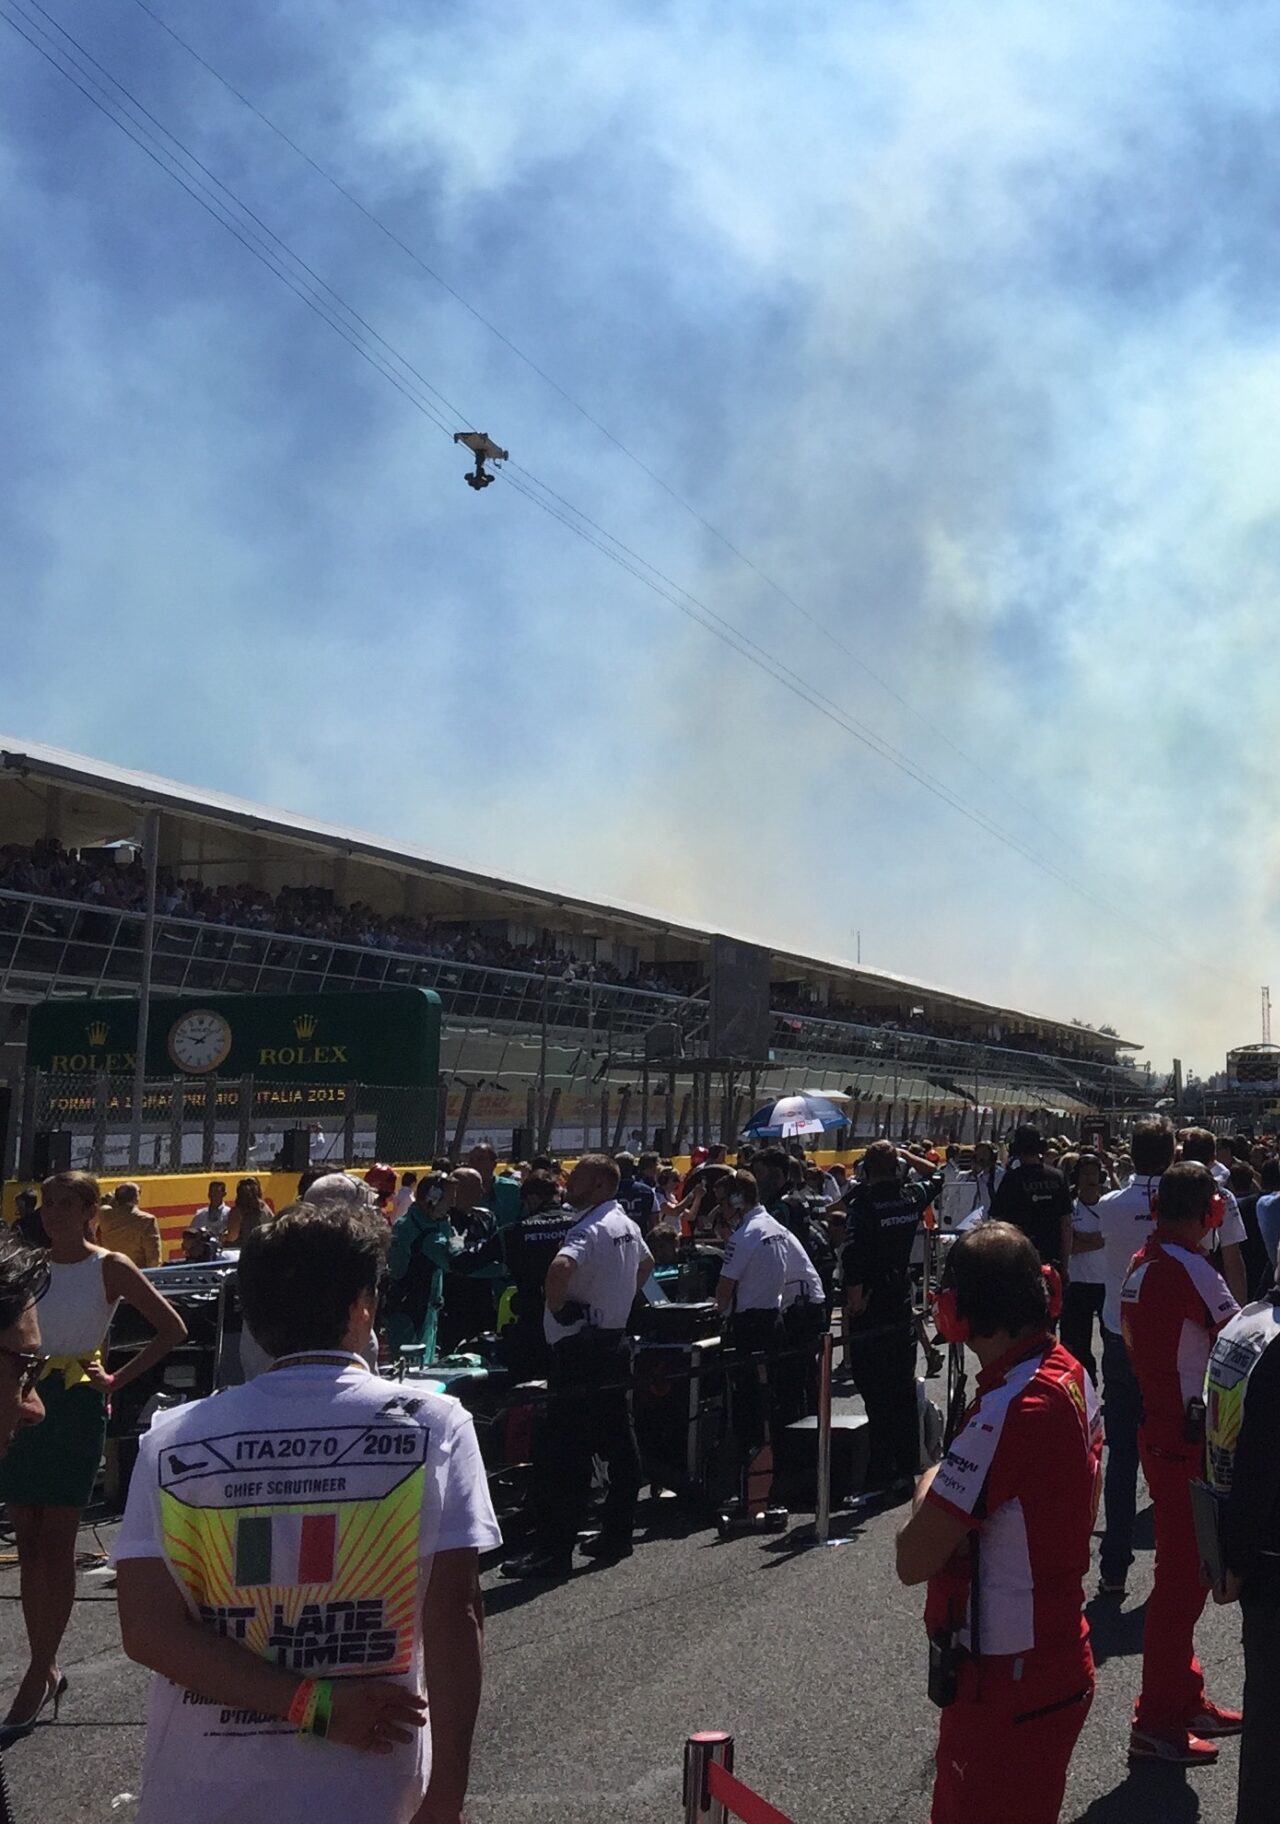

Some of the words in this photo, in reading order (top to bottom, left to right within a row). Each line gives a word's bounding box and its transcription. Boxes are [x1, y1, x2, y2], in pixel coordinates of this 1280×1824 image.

[52, 1053, 138, 1072] ROLEX
[259, 1046, 348, 1066] ROLEX
[308, 1089, 346, 1102] 2015
[524, 1230, 568, 1241] PETRON
[236, 1437, 338, 1460] ITA2070
[363, 1434, 416, 1455] 2015
[224, 1482, 262, 1498] CHIEF
[267, 1477, 346, 1495] SCRUTINEER
[201, 1606, 256, 1638] PIT
[274, 1599, 384, 1637] LANE
[268, 1630, 398, 1669] TIMES
